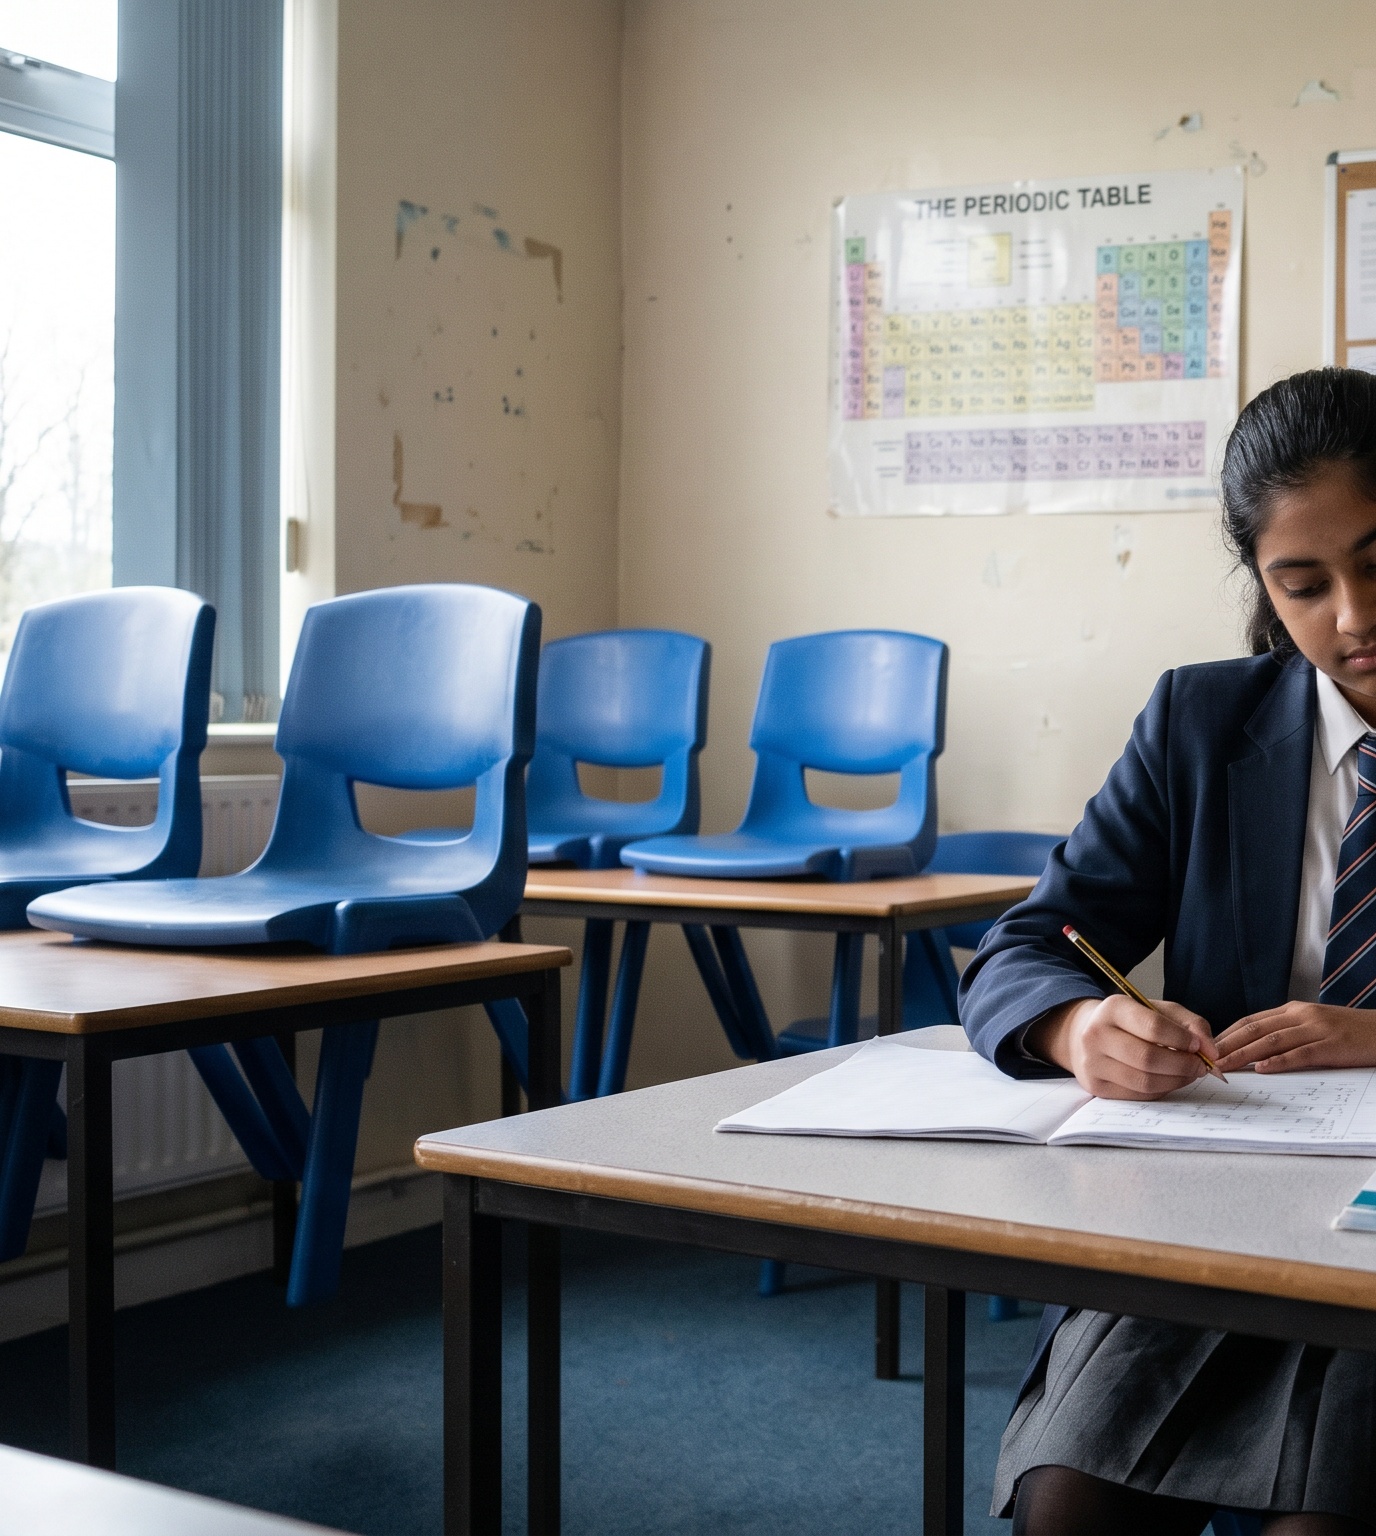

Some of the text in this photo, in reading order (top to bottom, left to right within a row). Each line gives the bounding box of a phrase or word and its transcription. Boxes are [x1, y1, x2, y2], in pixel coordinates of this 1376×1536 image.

[916, 183, 1153, 220] THE PERIODIC TABLE
[1124, 252, 1134, 263] C
[1147, 251, 1156, 262] N
[1169, 249, 1179, 261] O
[1147, 278, 1155, 288] P
[1056, 338, 1070, 351] Ag
